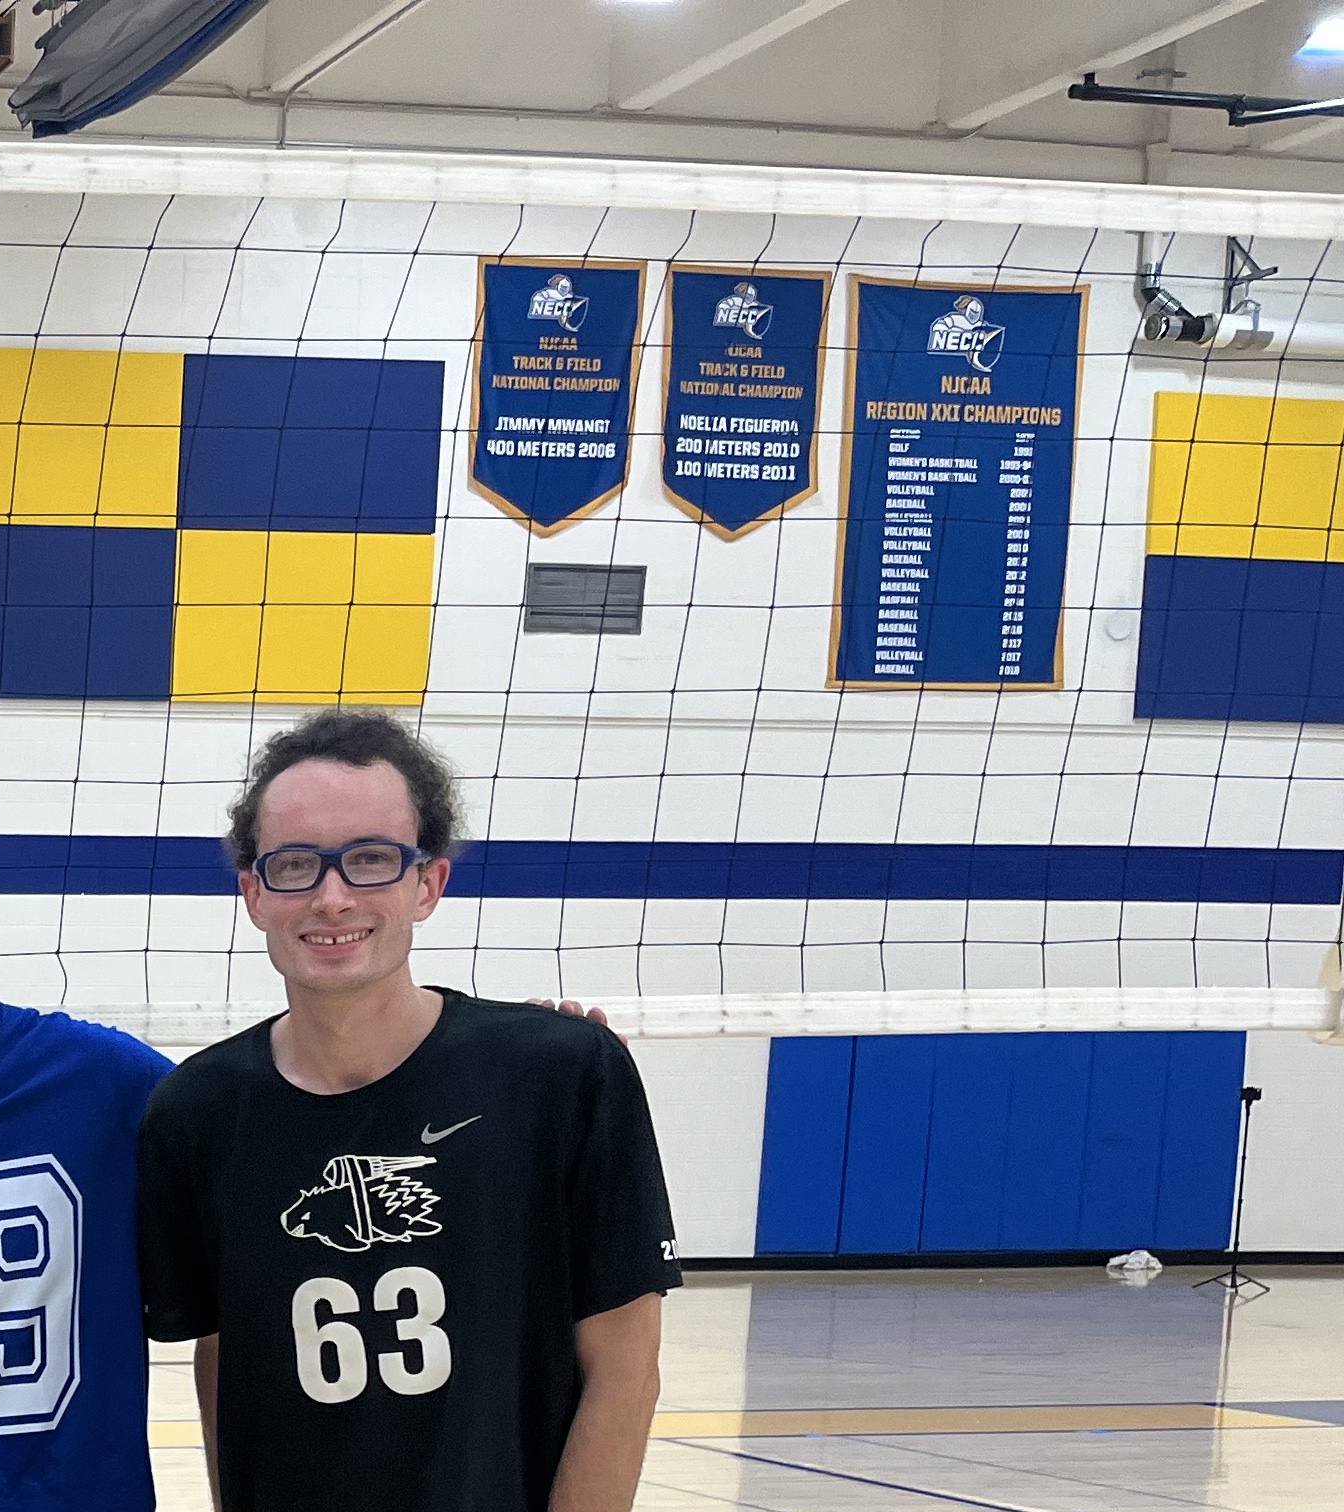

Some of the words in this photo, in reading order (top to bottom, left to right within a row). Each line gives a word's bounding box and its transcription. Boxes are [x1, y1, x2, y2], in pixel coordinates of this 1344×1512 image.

[532, 302, 572, 316] NECC
[717, 308, 758, 323] NECC
[932, 331, 985, 351] NECC
[513, 356, 553, 370] TRACK
[567, 358, 601, 372] FIELD
[752, 365, 785, 379] FIELD
[493, 375, 551, 390] NATIONAL
[553, 377, 620, 392] CHAMPION
[680, 381, 735, 396] NATIONAL
[738, 384, 803, 399] CHAMPION
[941, 375, 991, 395] NJCAA
[866, 402, 927, 421] REGION
[931, 403, 960, 421] XXI
[964, 404, 1062, 425] CHAMPIONS
[495, 417, 545, 434] JIMMY
[548, 418, 610, 435] MWANGI
[487, 440, 514, 455] 400
[518, 441, 575, 457] METERS
[578, 442, 616, 458] 2006
[676, 437, 702, 453] 200
[705, 439, 761, 457] METERS
[763, 443, 800, 458] 2010
[889, 443, 910, 453] GOLF
[888, 457, 927, 467] WOMEN'S
[675, 460, 701, 476] 100
[704, 462, 759, 479] METERS
[762, 465, 795, 480] 2011
[887, 485, 934, 495] VOLLEYBALL
[886, 499, 926, 510] BASEBALL
[884, 527, 932, 537] VOLLEYBALL
[883, 541, 931, 551] VOLLEYBALL
[882, 554, 922, 564] BASEBALL
[881, 568, 930, 578] VOLLEYBALL
[881, 582, 920, 592] BASEBALL
[879, 609, 918, 619] BASEBALL
[878, 623, 917, 633] BASEBALL
[877, 637, 916, 647] BASEBALL
[876, 651, 924, 661] VOLLEYBALL
[292, 1266, 451, 1403] 63
